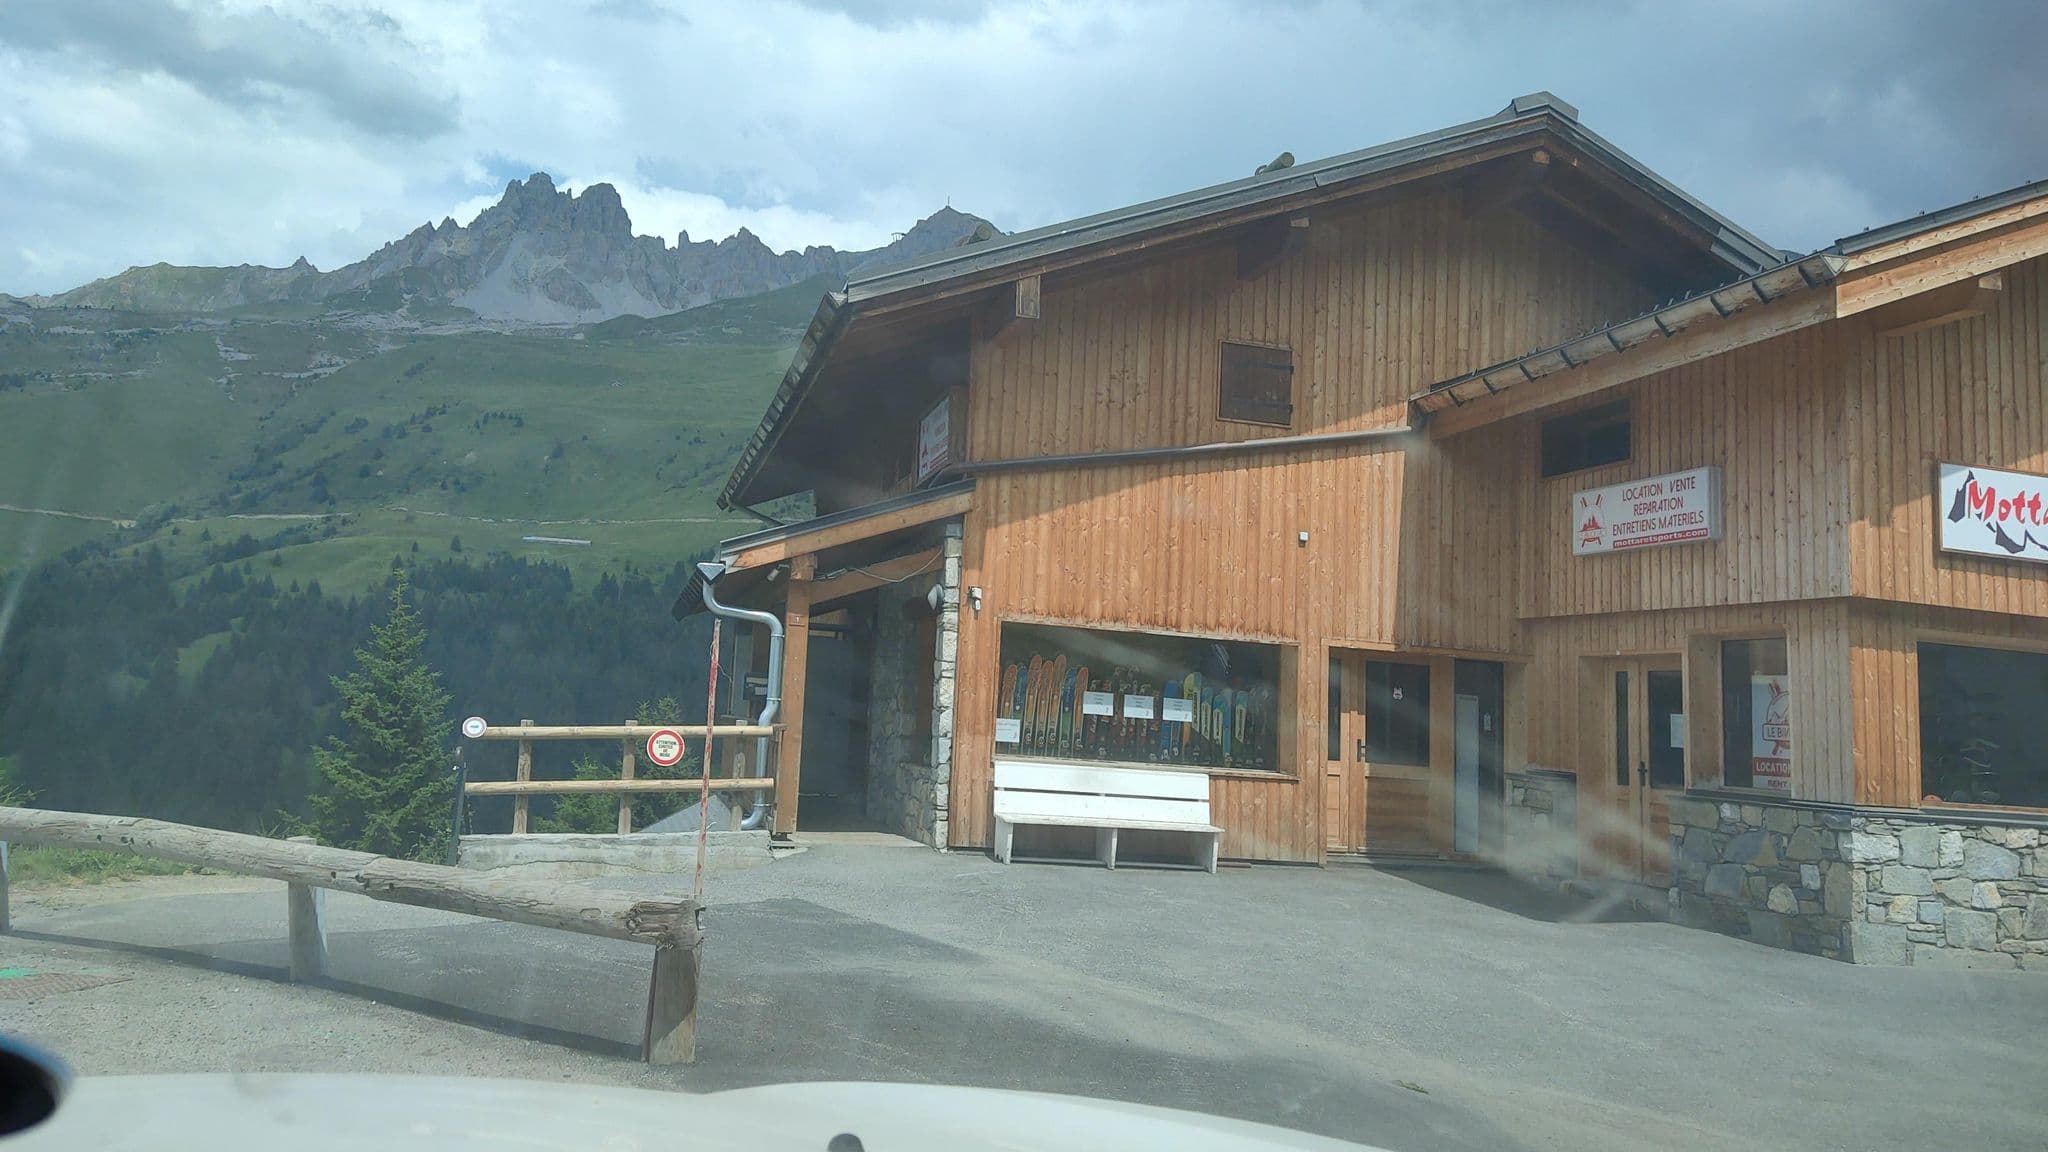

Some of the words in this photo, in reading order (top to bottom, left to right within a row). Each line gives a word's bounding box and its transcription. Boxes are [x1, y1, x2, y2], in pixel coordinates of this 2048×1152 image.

[1622, 483, 1663, 502] LOCATION
[1669, 476, 1696, 493] VENTE
[1612, 517, 1656, 536] ENTRETIENS
[1658, 510, 1704, 529] MATERIELS
[1614, 528, 1707, 547] mottaretsports.com
[1767, 727, 1776, 738] LE
